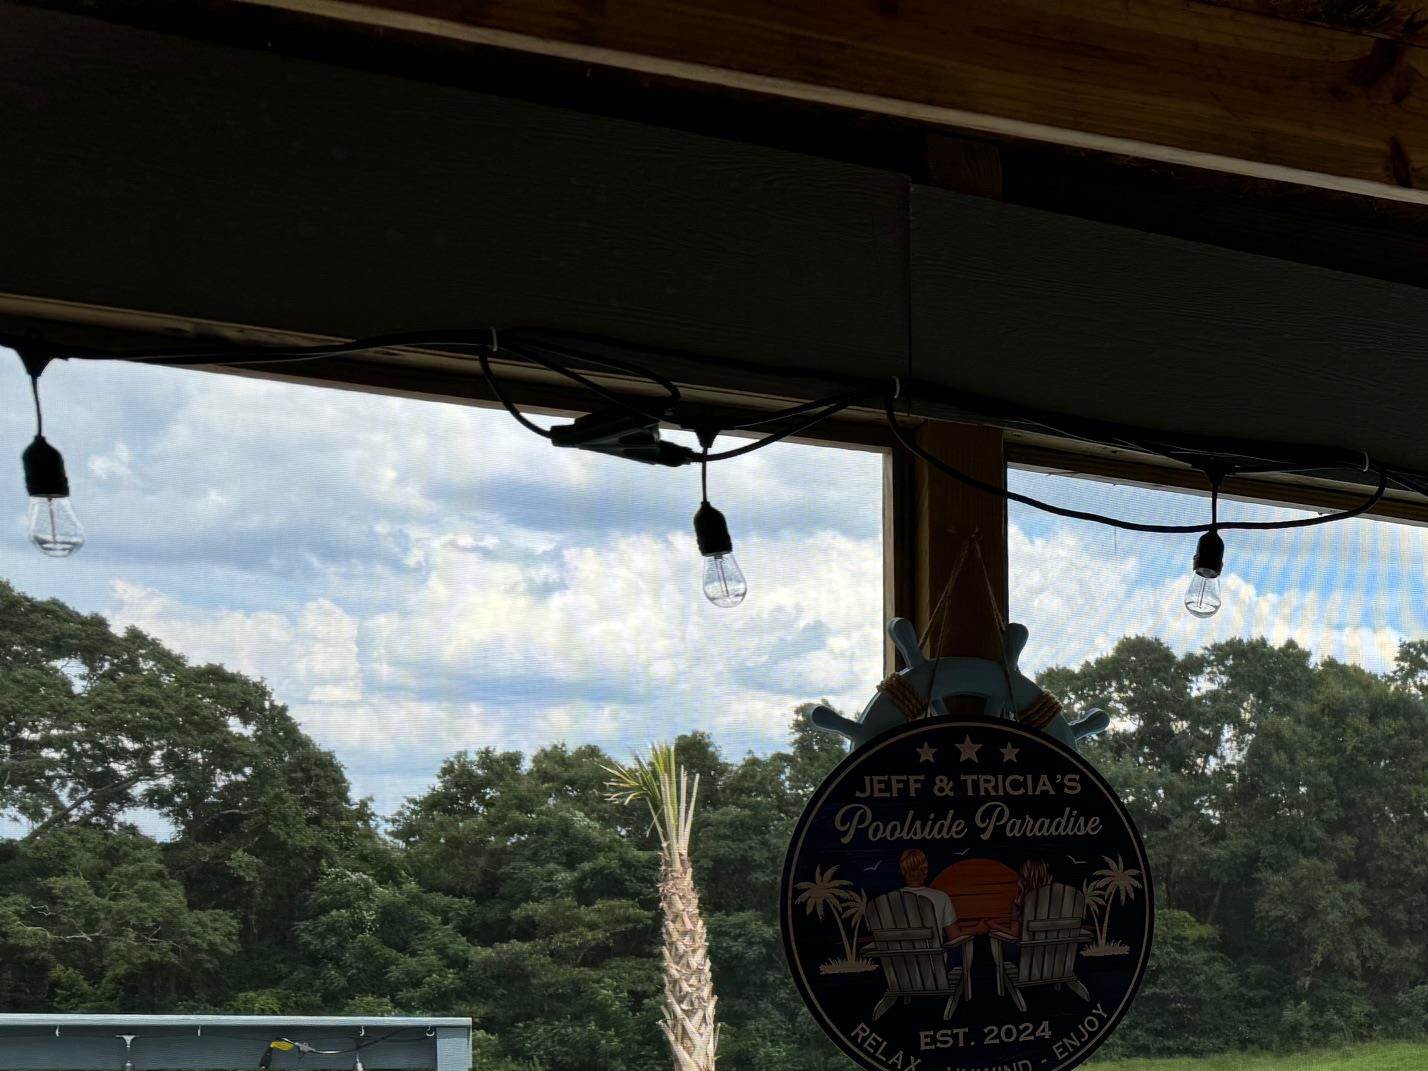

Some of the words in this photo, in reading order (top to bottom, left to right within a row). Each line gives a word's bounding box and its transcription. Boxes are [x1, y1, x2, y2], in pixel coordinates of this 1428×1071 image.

[855, 775, 925, 798] JEFF
[932, 775, 955, 796] &
[960, 774, 1083, 797] TRICIA'S
[834, 803, 968, 844] Poolside
[974, 801, 1103, 841] Paradise
[919, 1028, 976, 1051] EST.
[984, 1021, 1052, 1046] 2024
[1052, 1003, 1109, 1061] ENJOY
